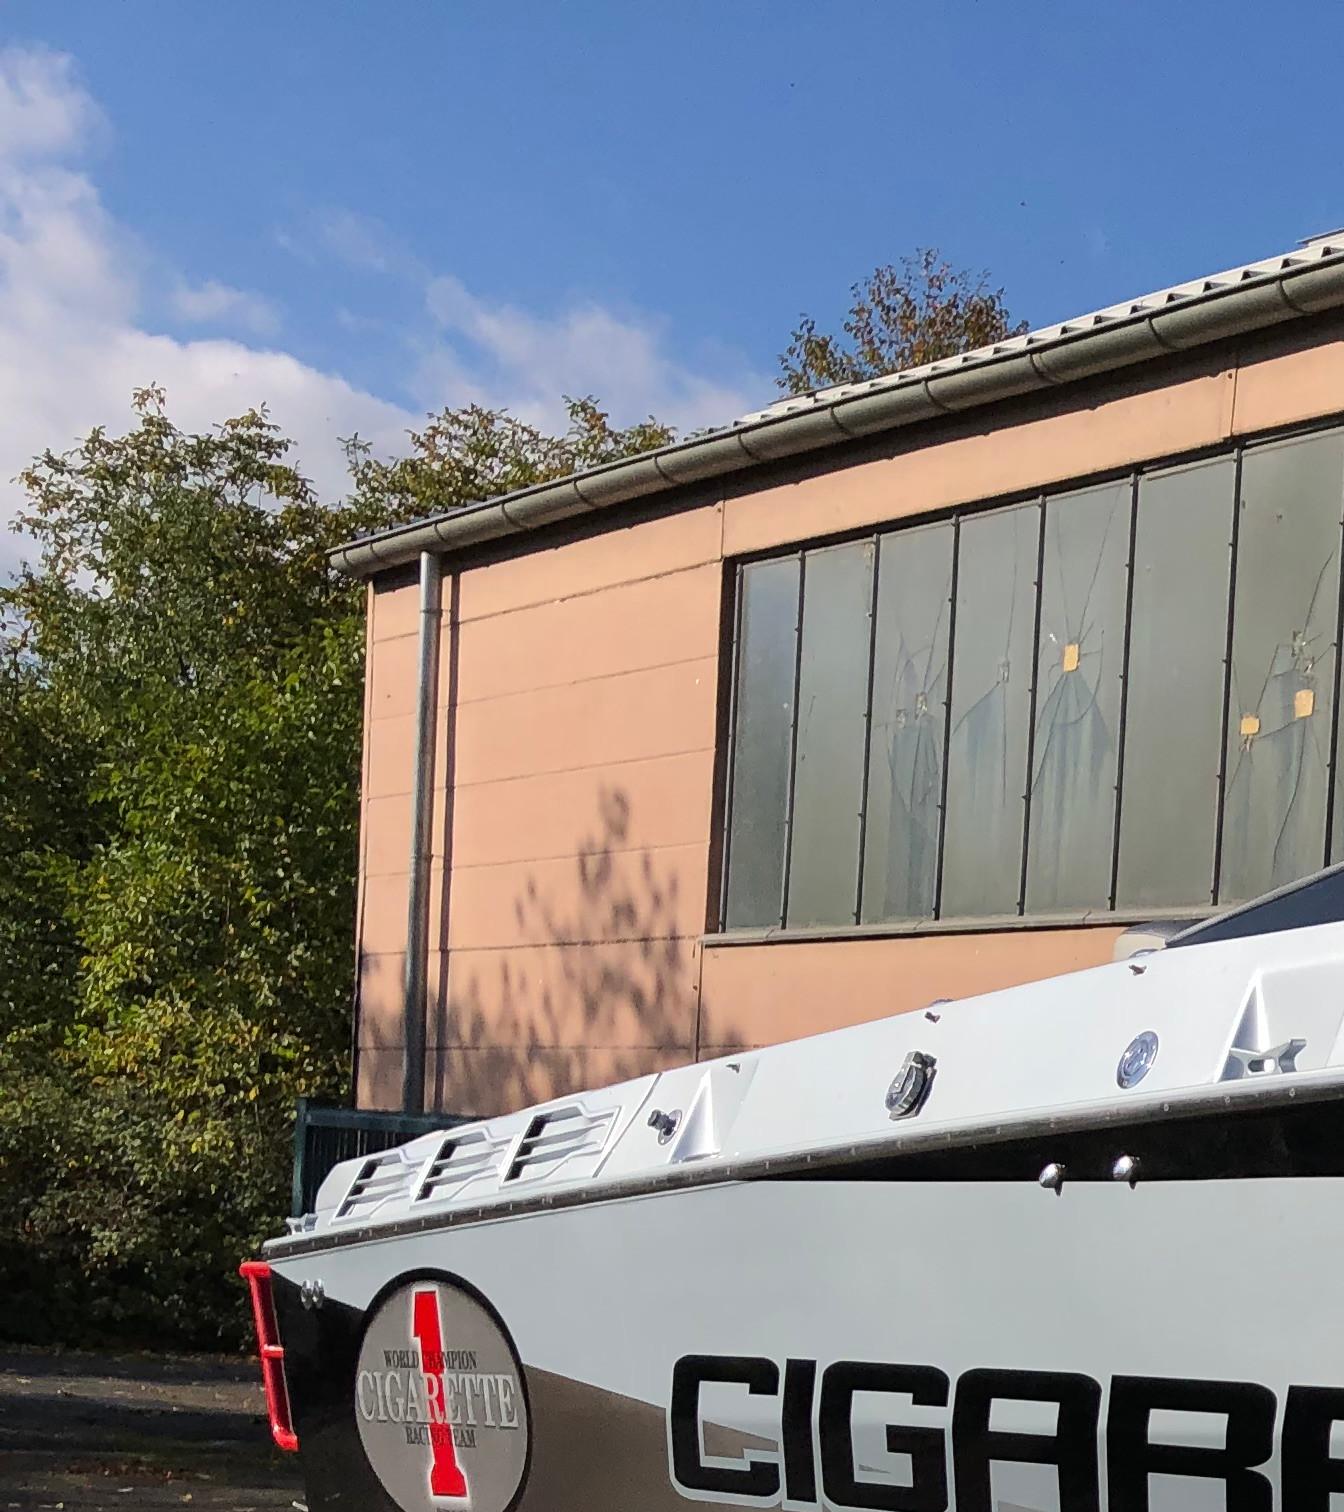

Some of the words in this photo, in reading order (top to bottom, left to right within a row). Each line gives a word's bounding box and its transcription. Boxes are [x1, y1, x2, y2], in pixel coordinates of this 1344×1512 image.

[384, 1350, 419, 1369] WORLD
[357, 1370, 519, 1428] CIGARETTE
[412, 1290, 468, 1498] 1
[448, 1428, 476, 1448] EAM
